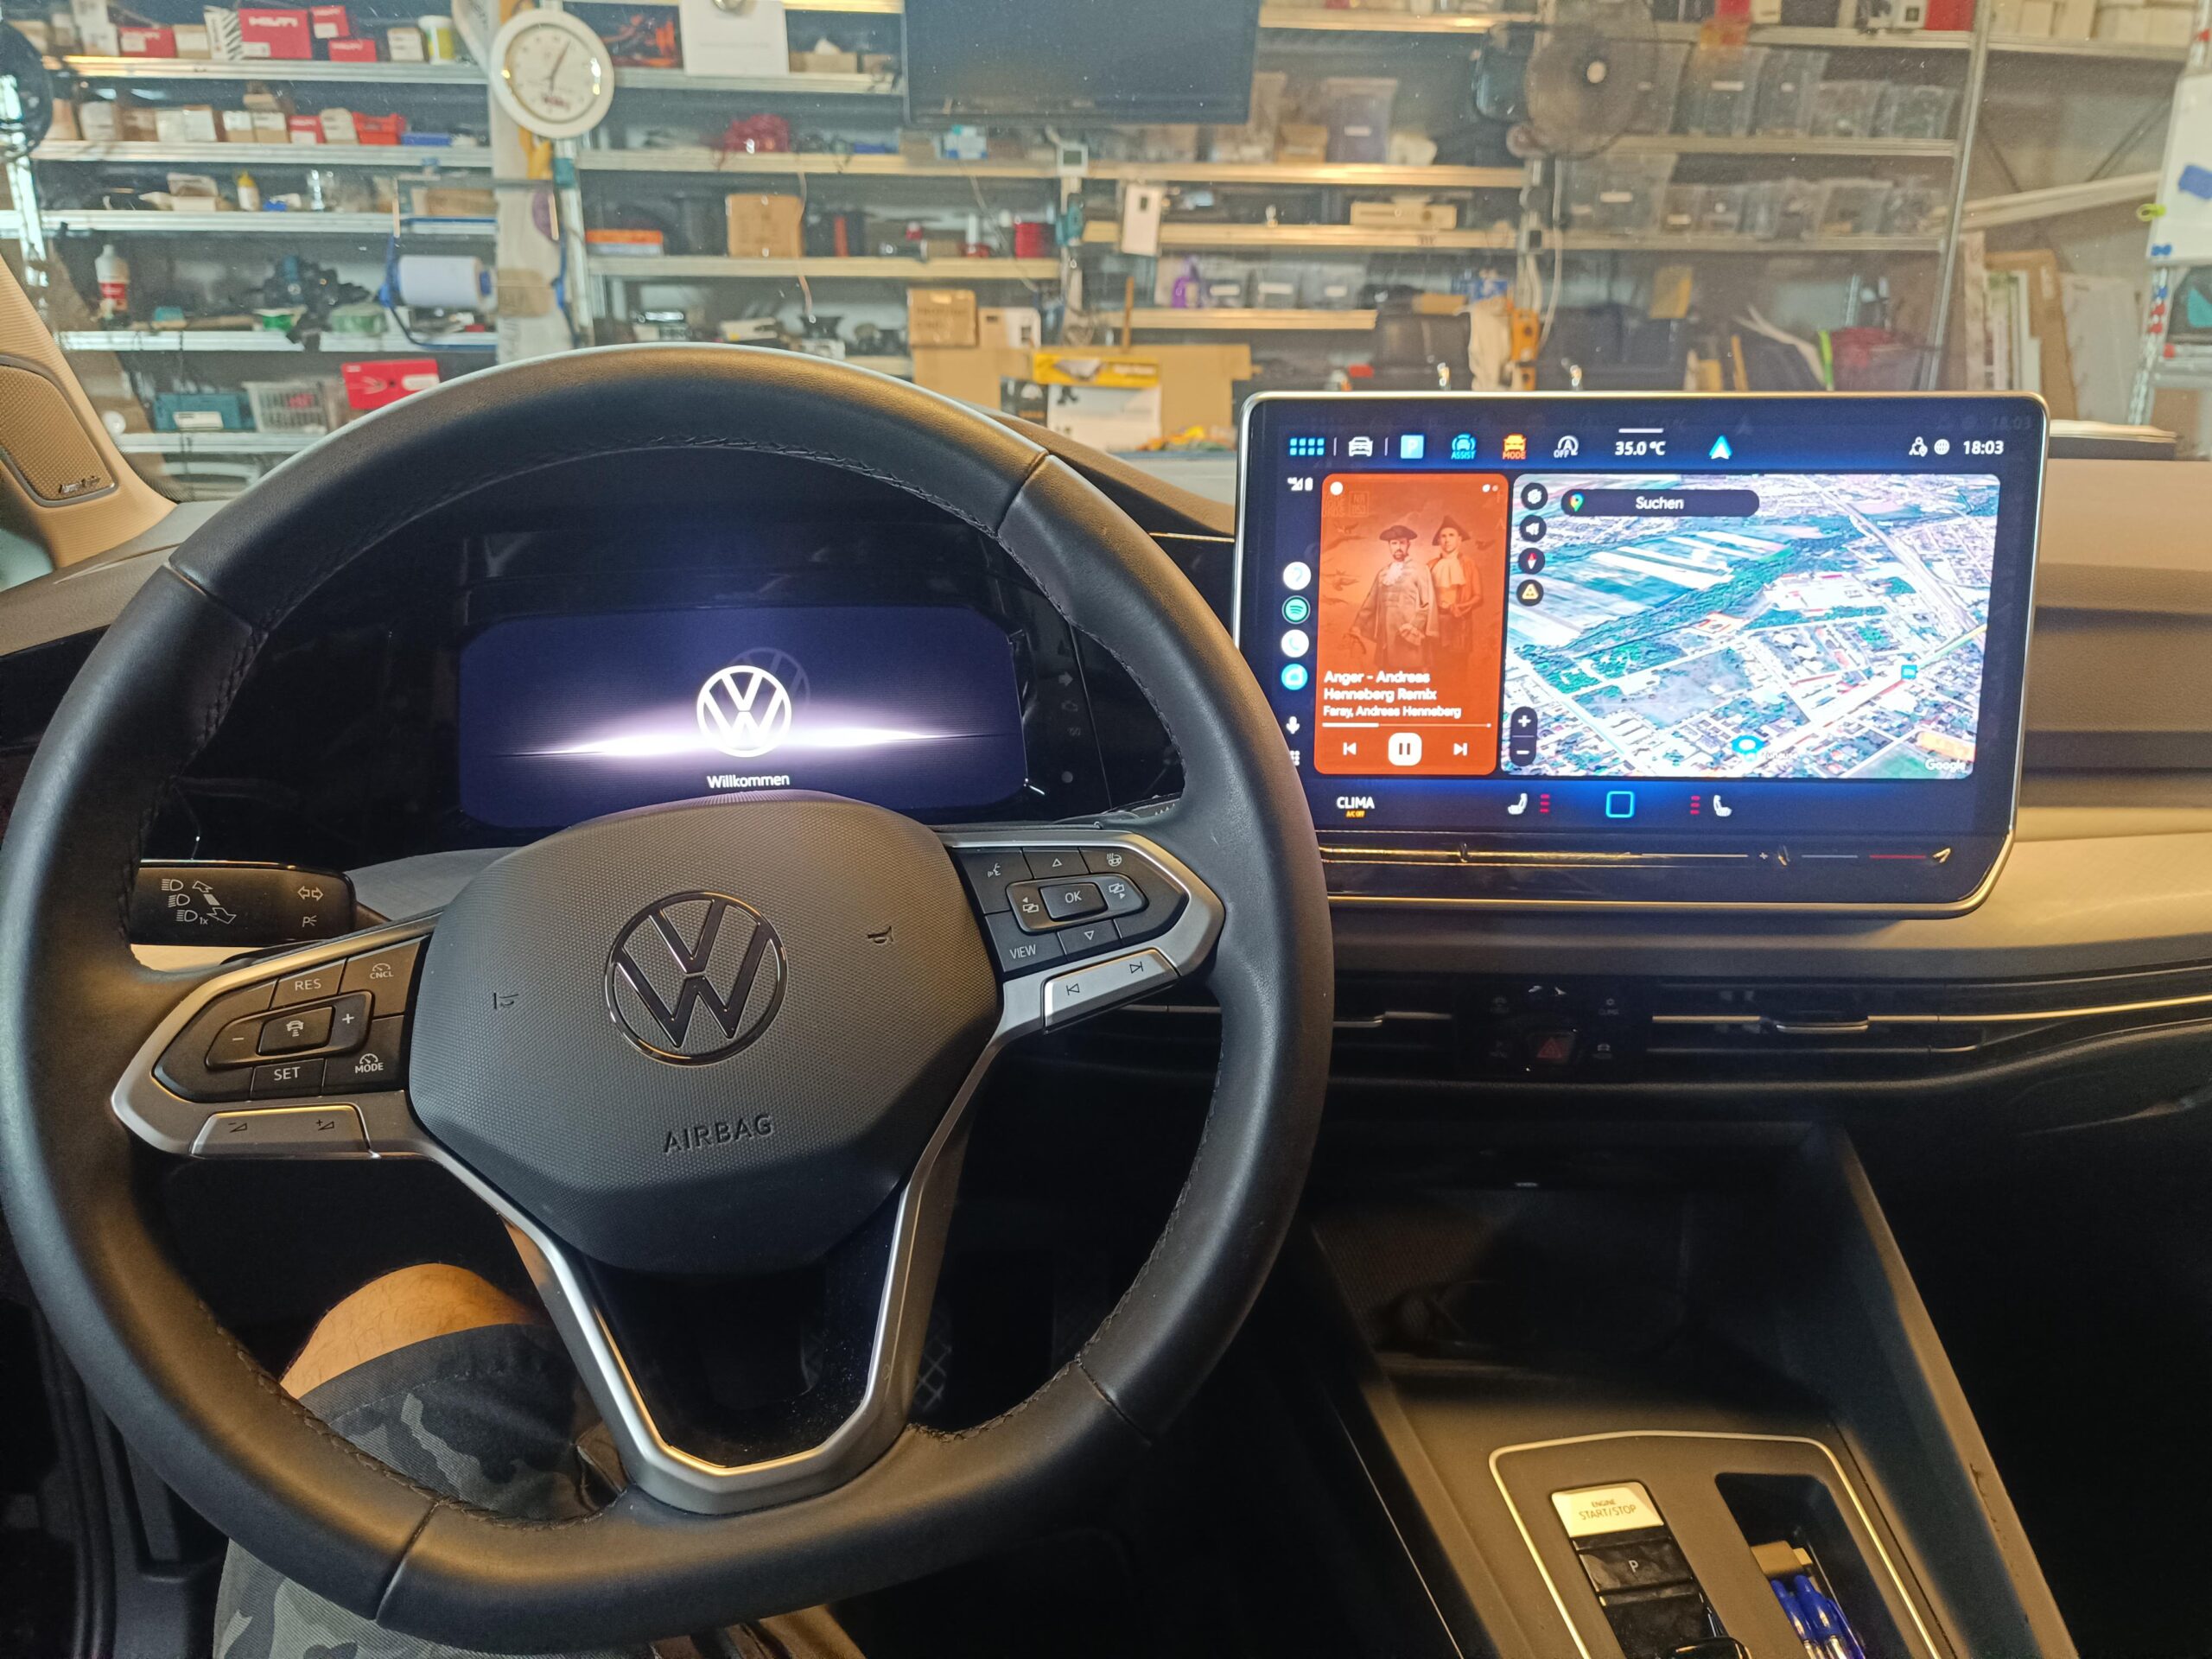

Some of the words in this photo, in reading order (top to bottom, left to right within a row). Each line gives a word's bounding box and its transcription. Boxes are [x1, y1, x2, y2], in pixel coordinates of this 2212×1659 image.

[1553, 448, 1569, 459] OFF
[1614, 441, 1647, 455] 35.0
[1962, 440, 2004, 455] 18:03
[1451, 450, 1477, 460] ASSIST
[1502, 450, 1527, 460] MODE
[1635, 496, 1685, 510] Suchen
[1324, 671, 1364, 685] Anger
[1376, 671, 1430, 683] Andreas
[1324, 688, 1395, 702] Henneberg
[1397, 688, 1437, 700] Remix
[1356, 705, 1401, 716] Andreas
[1402, 705, 1462, 719] Henneberg
[1924, 759, 1967, 772] Google
[706, 774, 791, 789] Willkommen
[1336, 796, 1376, 810] CLIMA
[1065, 890, 1082, 904] OK
[200, 917, 209, 925] 1x
[1009, 944, 1036, 959] VIEW
[369, 970, 394, 980] CNCL
[295, 978, 321, 991] RES
[273, 1066, 301, 1081] SET
[354, 1062, 384, 1074] MODE
[663, 1113, 775, 1154] AIRBAG
[1579, 1504, 1636, 1520] START/STOP
[1629, 1560, 1638, 1572] P
